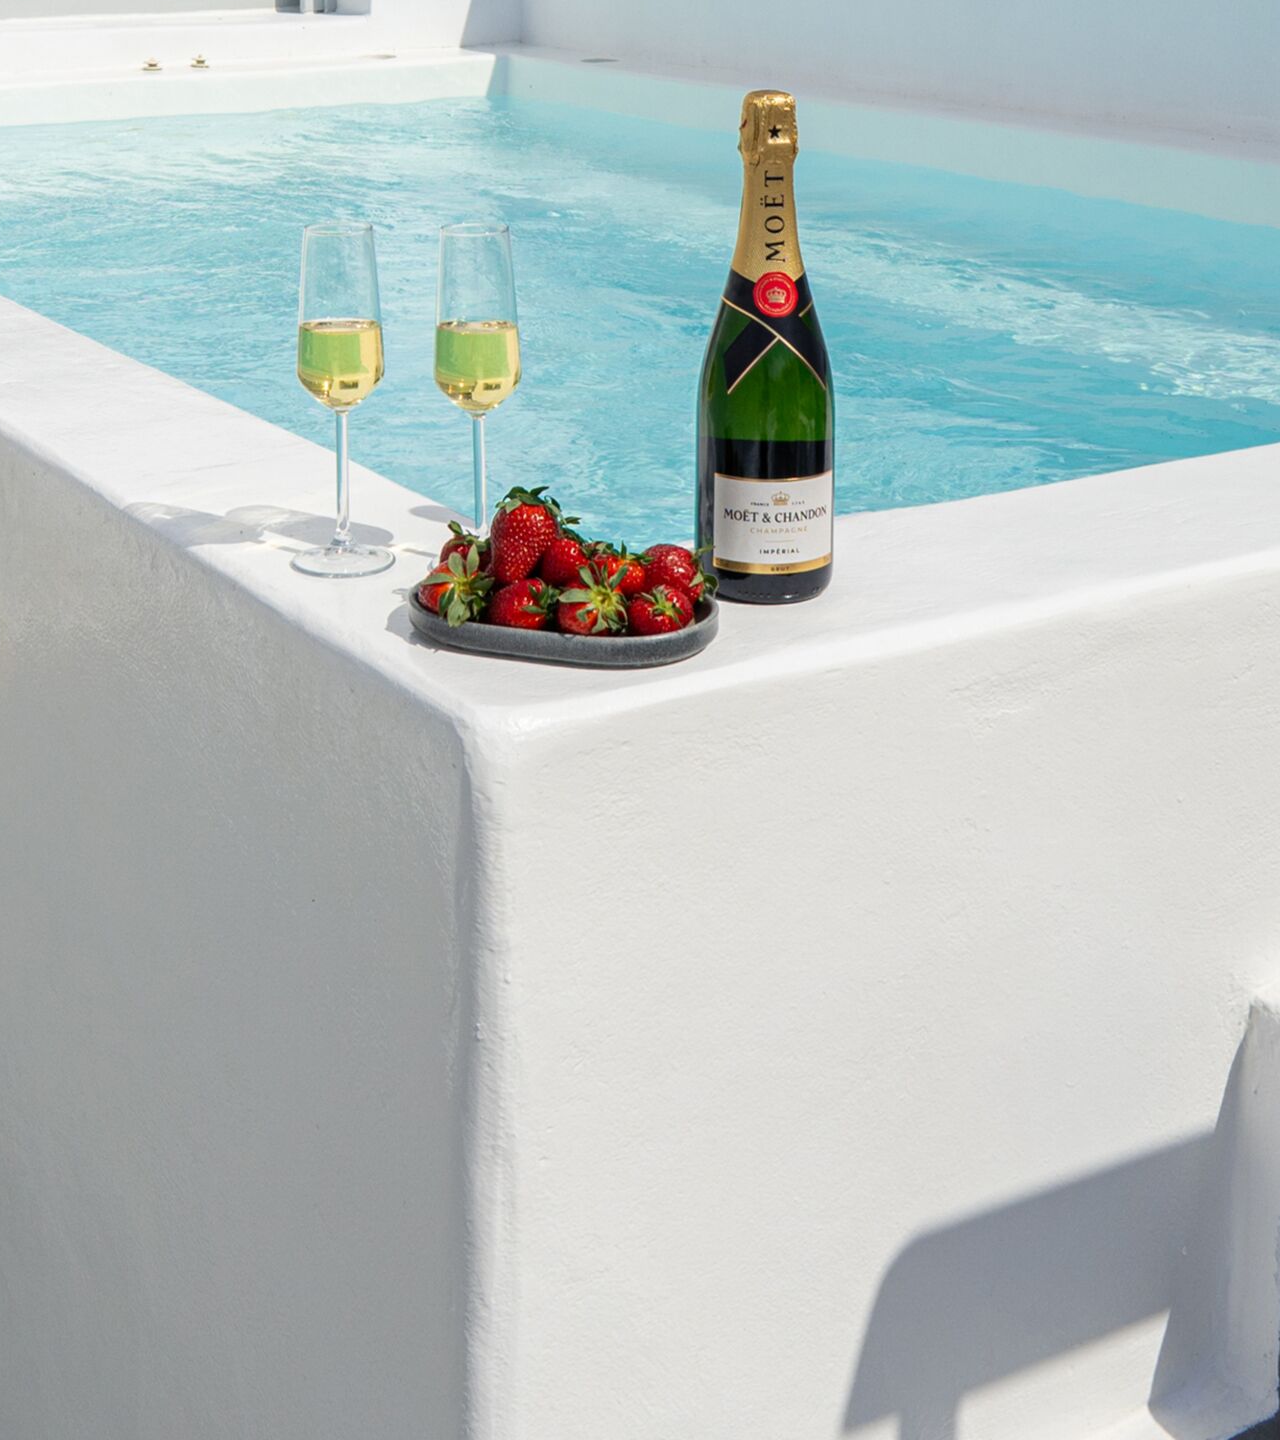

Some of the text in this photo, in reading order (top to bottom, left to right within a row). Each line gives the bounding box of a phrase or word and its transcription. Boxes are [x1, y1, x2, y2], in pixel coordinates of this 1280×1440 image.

[760, 170, 786, 262] MOËT
[762, 512, 771, 524] &
[774, 505, 827, 523] CHANDON
[749, 525, 808, 535] CHAMPAGNE
